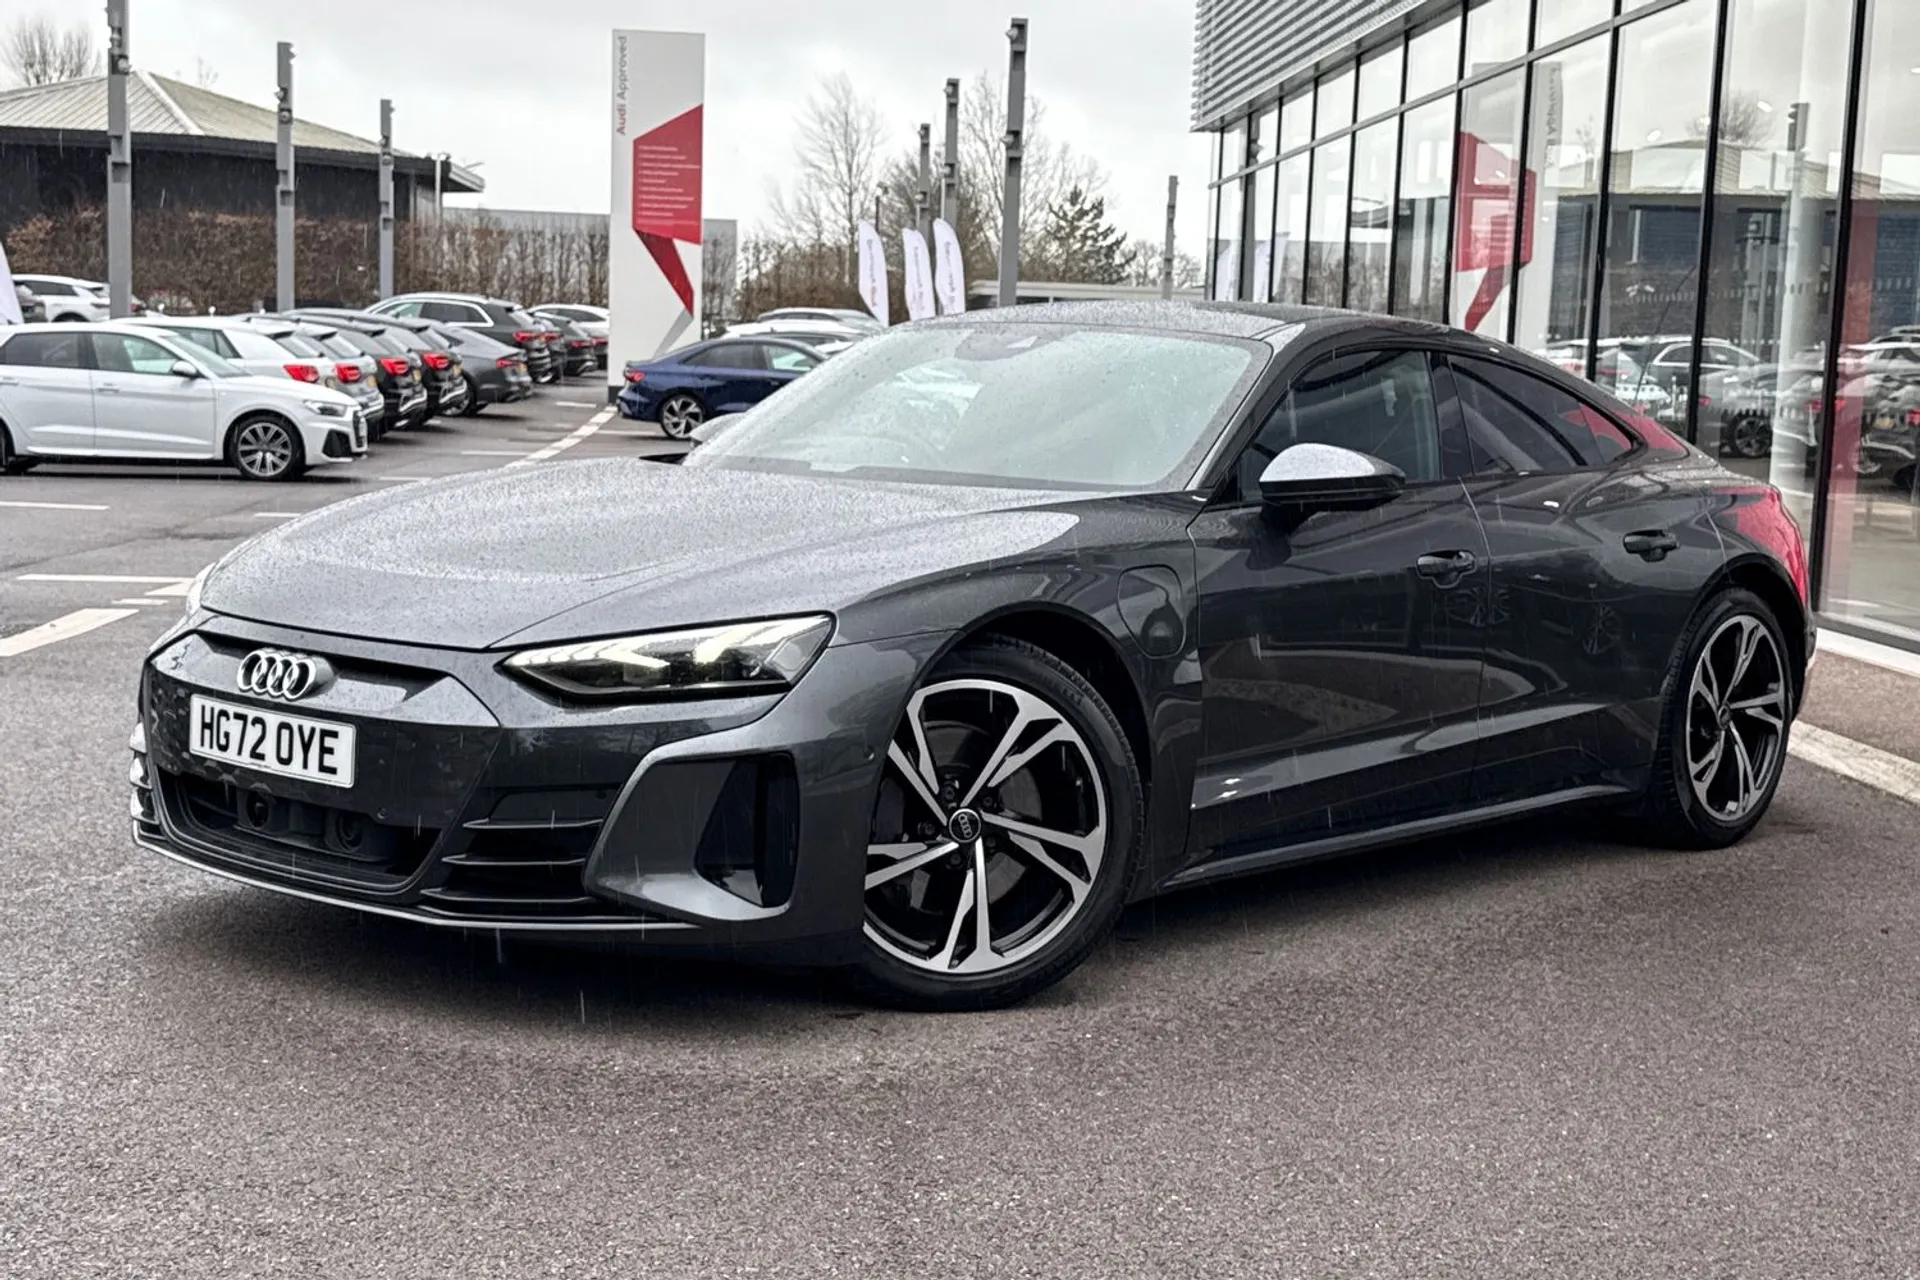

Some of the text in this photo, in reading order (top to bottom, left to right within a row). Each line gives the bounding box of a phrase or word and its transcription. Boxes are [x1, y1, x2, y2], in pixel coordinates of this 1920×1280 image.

[616, 37, 628, 135] Audi Approved
[200, 705, 339, 775] HG72 OYE
